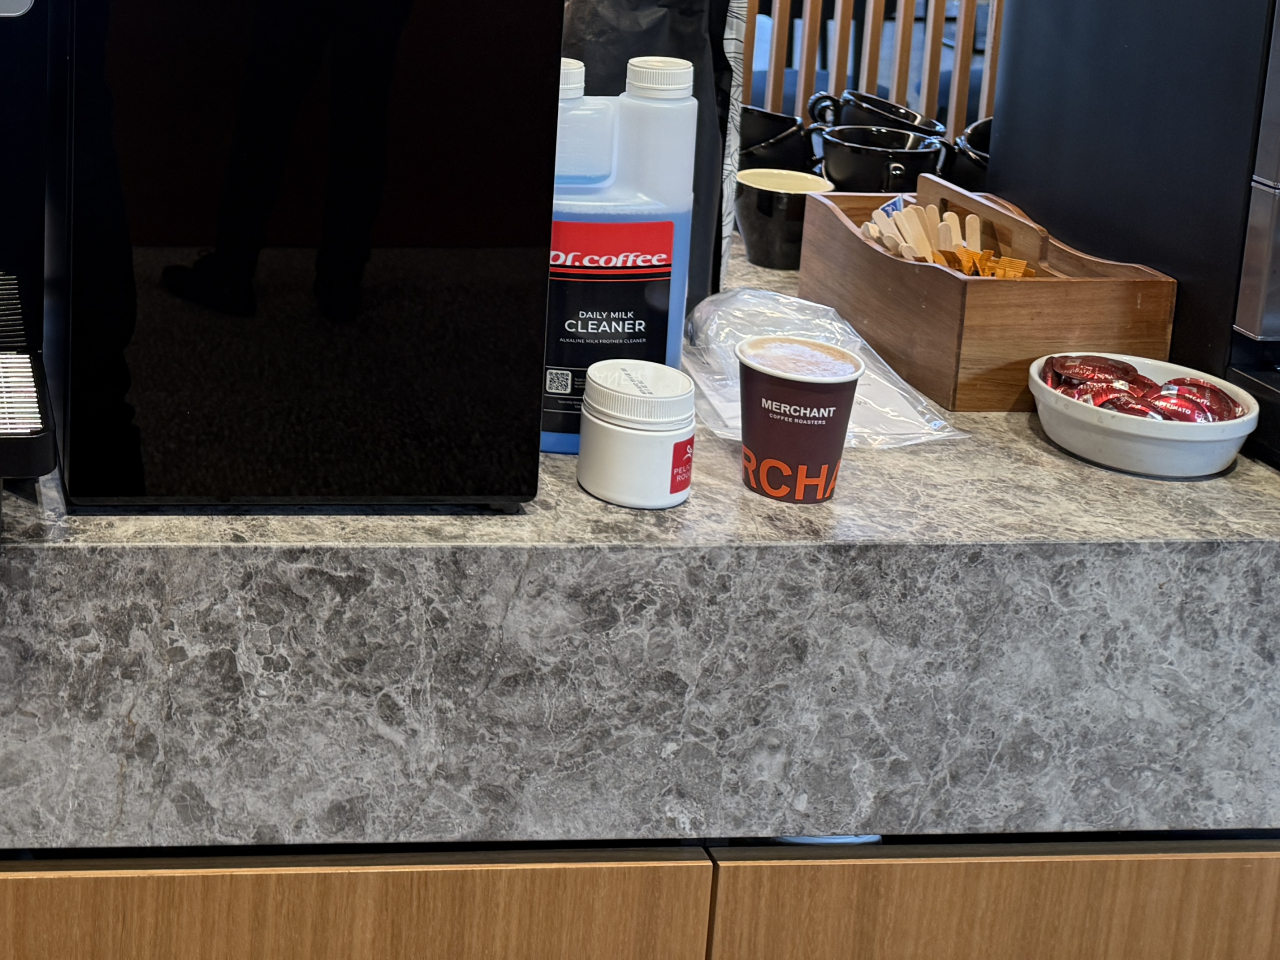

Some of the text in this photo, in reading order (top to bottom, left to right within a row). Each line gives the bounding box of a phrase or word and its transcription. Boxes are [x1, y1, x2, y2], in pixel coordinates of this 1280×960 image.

[550, 250, 668, 268] Dr.coffee
[579, 311, 634, 319] DAILY MILK
[564, 319, 646, 333] CLEANER
[761, 397, 836, 418] MERCHANT
[769, 412, 826, 425] COFFEE ROASTERS
